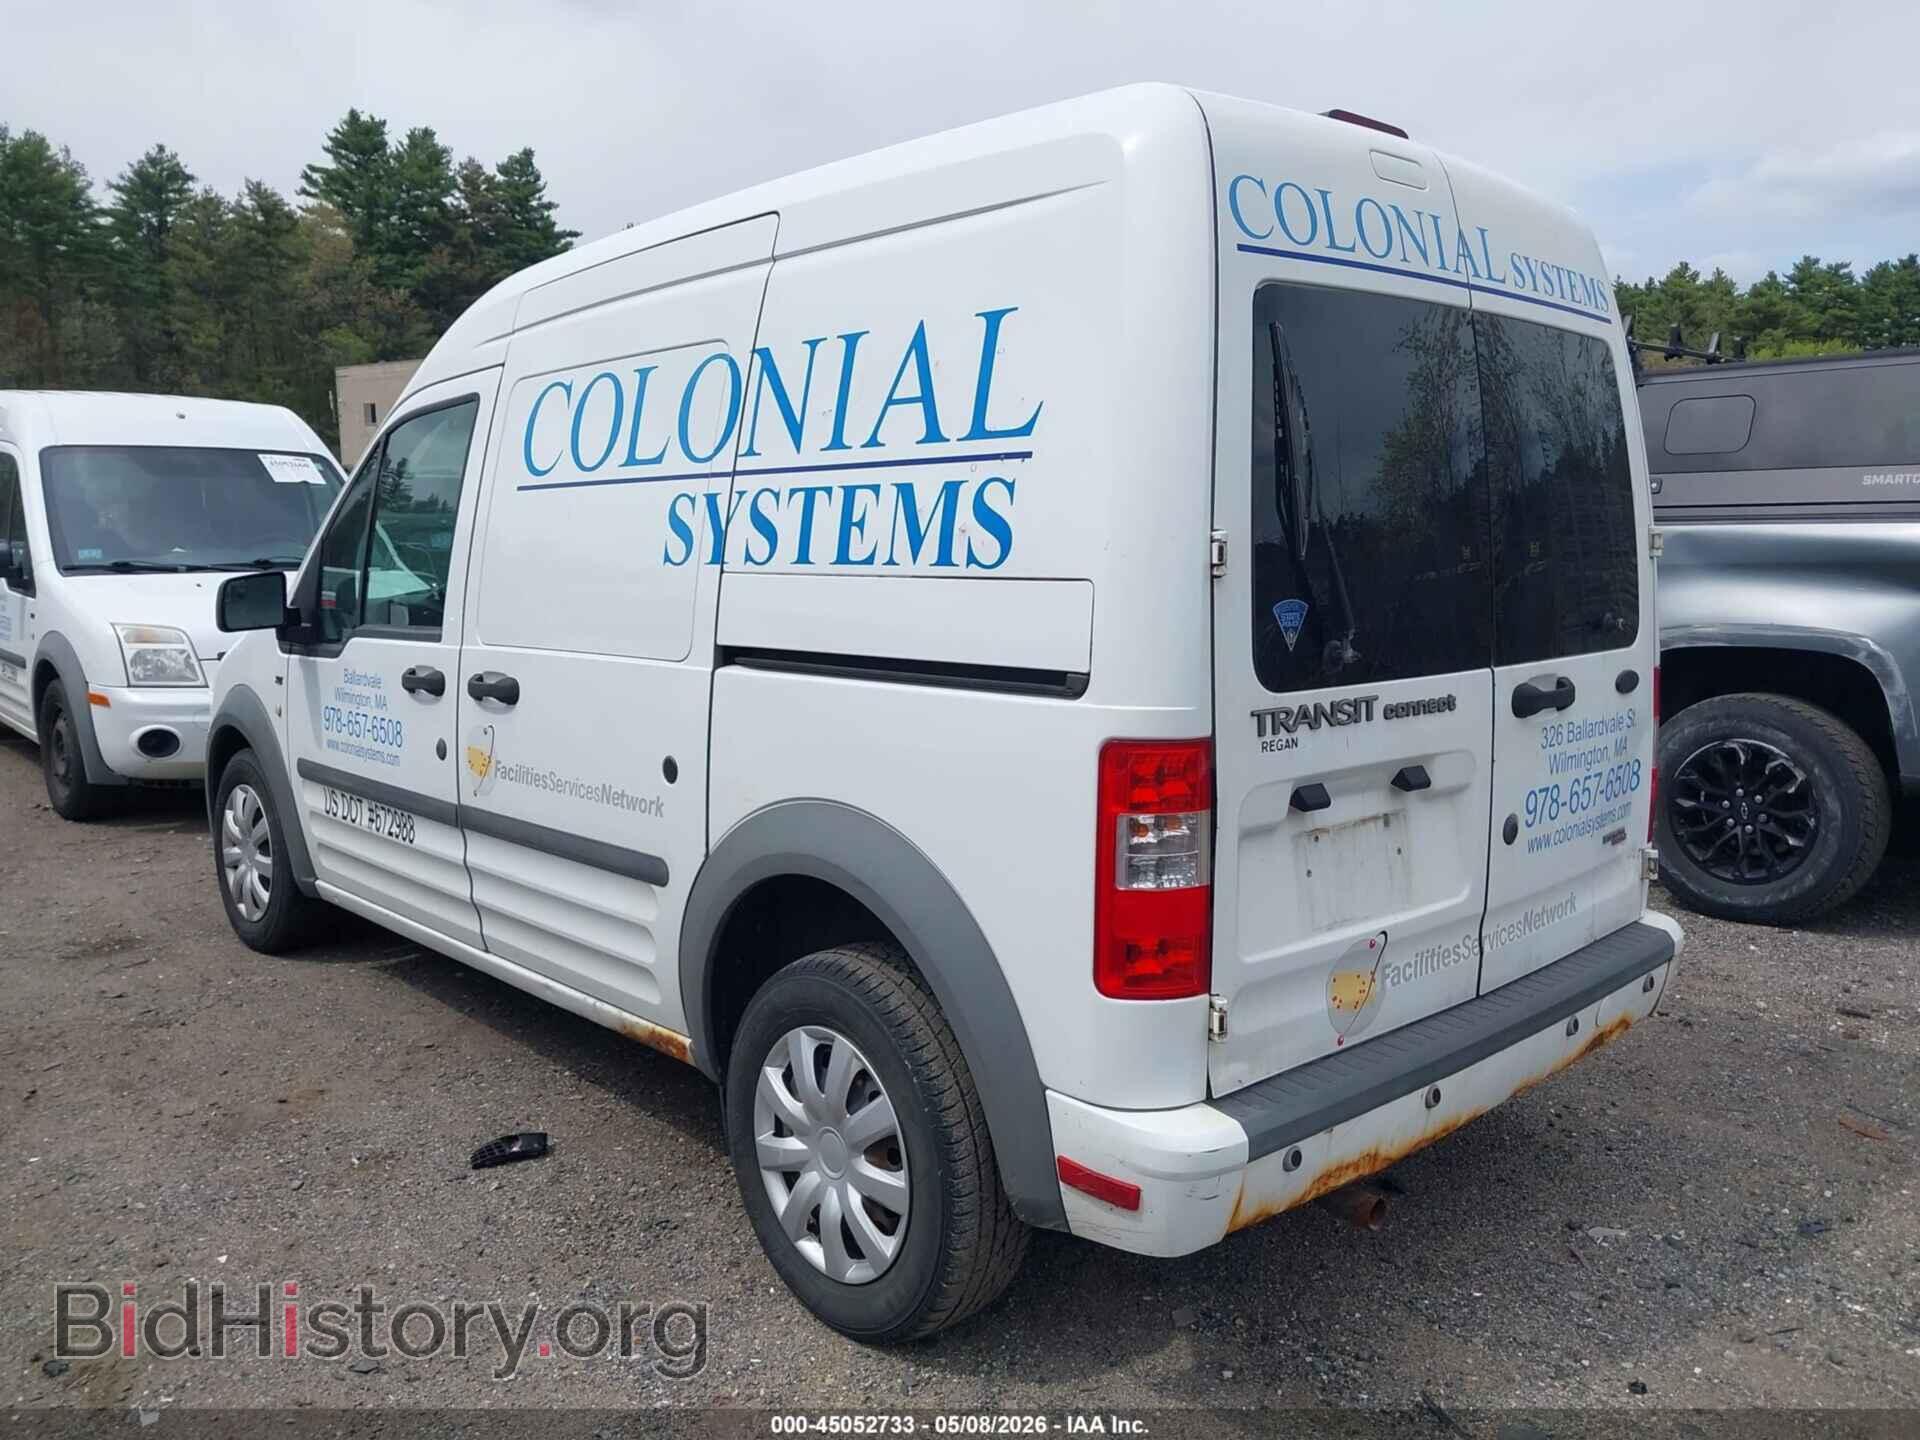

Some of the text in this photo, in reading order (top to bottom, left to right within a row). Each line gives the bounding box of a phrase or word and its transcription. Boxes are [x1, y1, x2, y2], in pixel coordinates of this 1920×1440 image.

[1228, 173, 1611, 313] COLONIAL SYSTEMS
[523, 306, 1044, 478] COLONIAL
[662, 477, 1017, 571] SYSTEMS
[323, 704, 403, 749] 978-657-6508
[374, 694, 388, 712] MA
[1251, 694, 1457, 738] TRANSIT connect
[1541, 723, 1564, 750] 326
[1567, 712, 1625, 744] Ballardvale
[1261, 737, 1299, 753] REGAN
[1549, 735, 1628, 775] Wilmington, MA
[323, 785, 416, 845] US DOT #672988
[494, 759, 665, 818] FacilitiesServicesNetwork
[1524, 758, 1641, 828] 978-657-6508
[1527, 801, 1632, 854] www.colonialsystems.com
[1381, 890, 1577, 988] FacilitiesServicesNetwork
